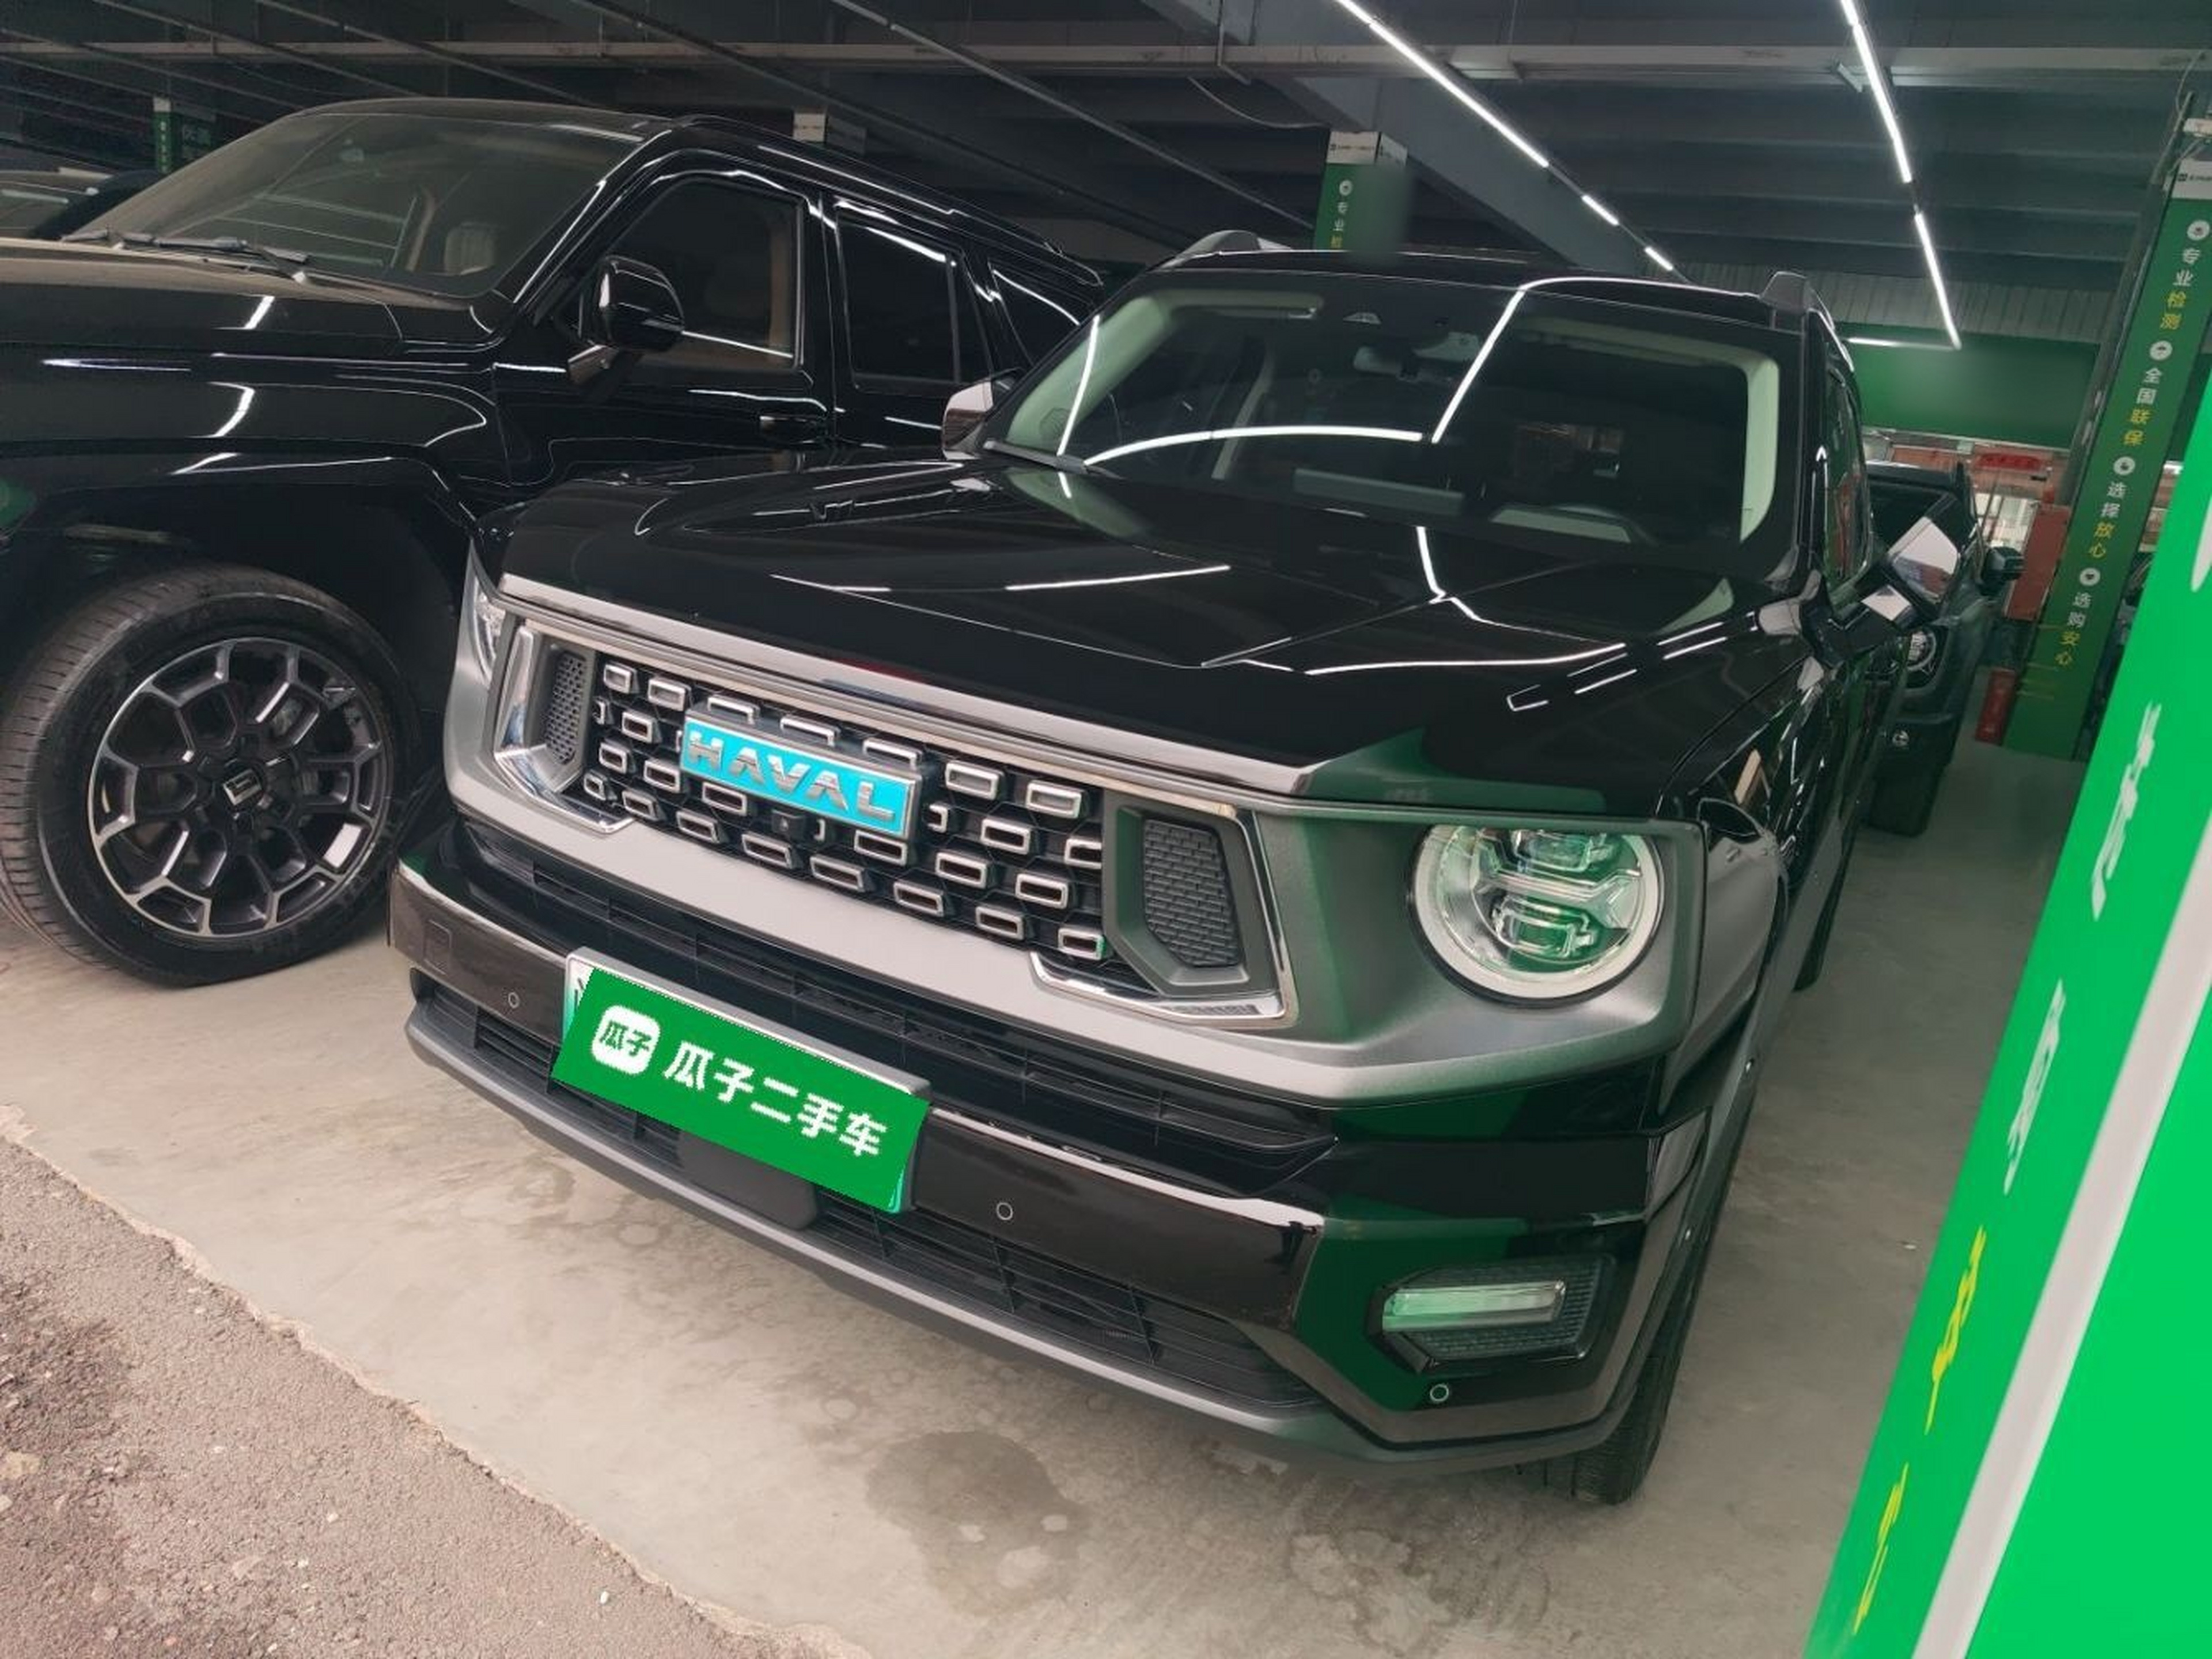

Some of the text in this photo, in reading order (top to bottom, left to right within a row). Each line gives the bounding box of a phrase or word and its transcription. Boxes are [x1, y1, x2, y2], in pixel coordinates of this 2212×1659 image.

[2055, 248, 2201, 666] 专业检测 全国联保 选择放心 选购安心
[687, 729, 896, 823] HAVAL
